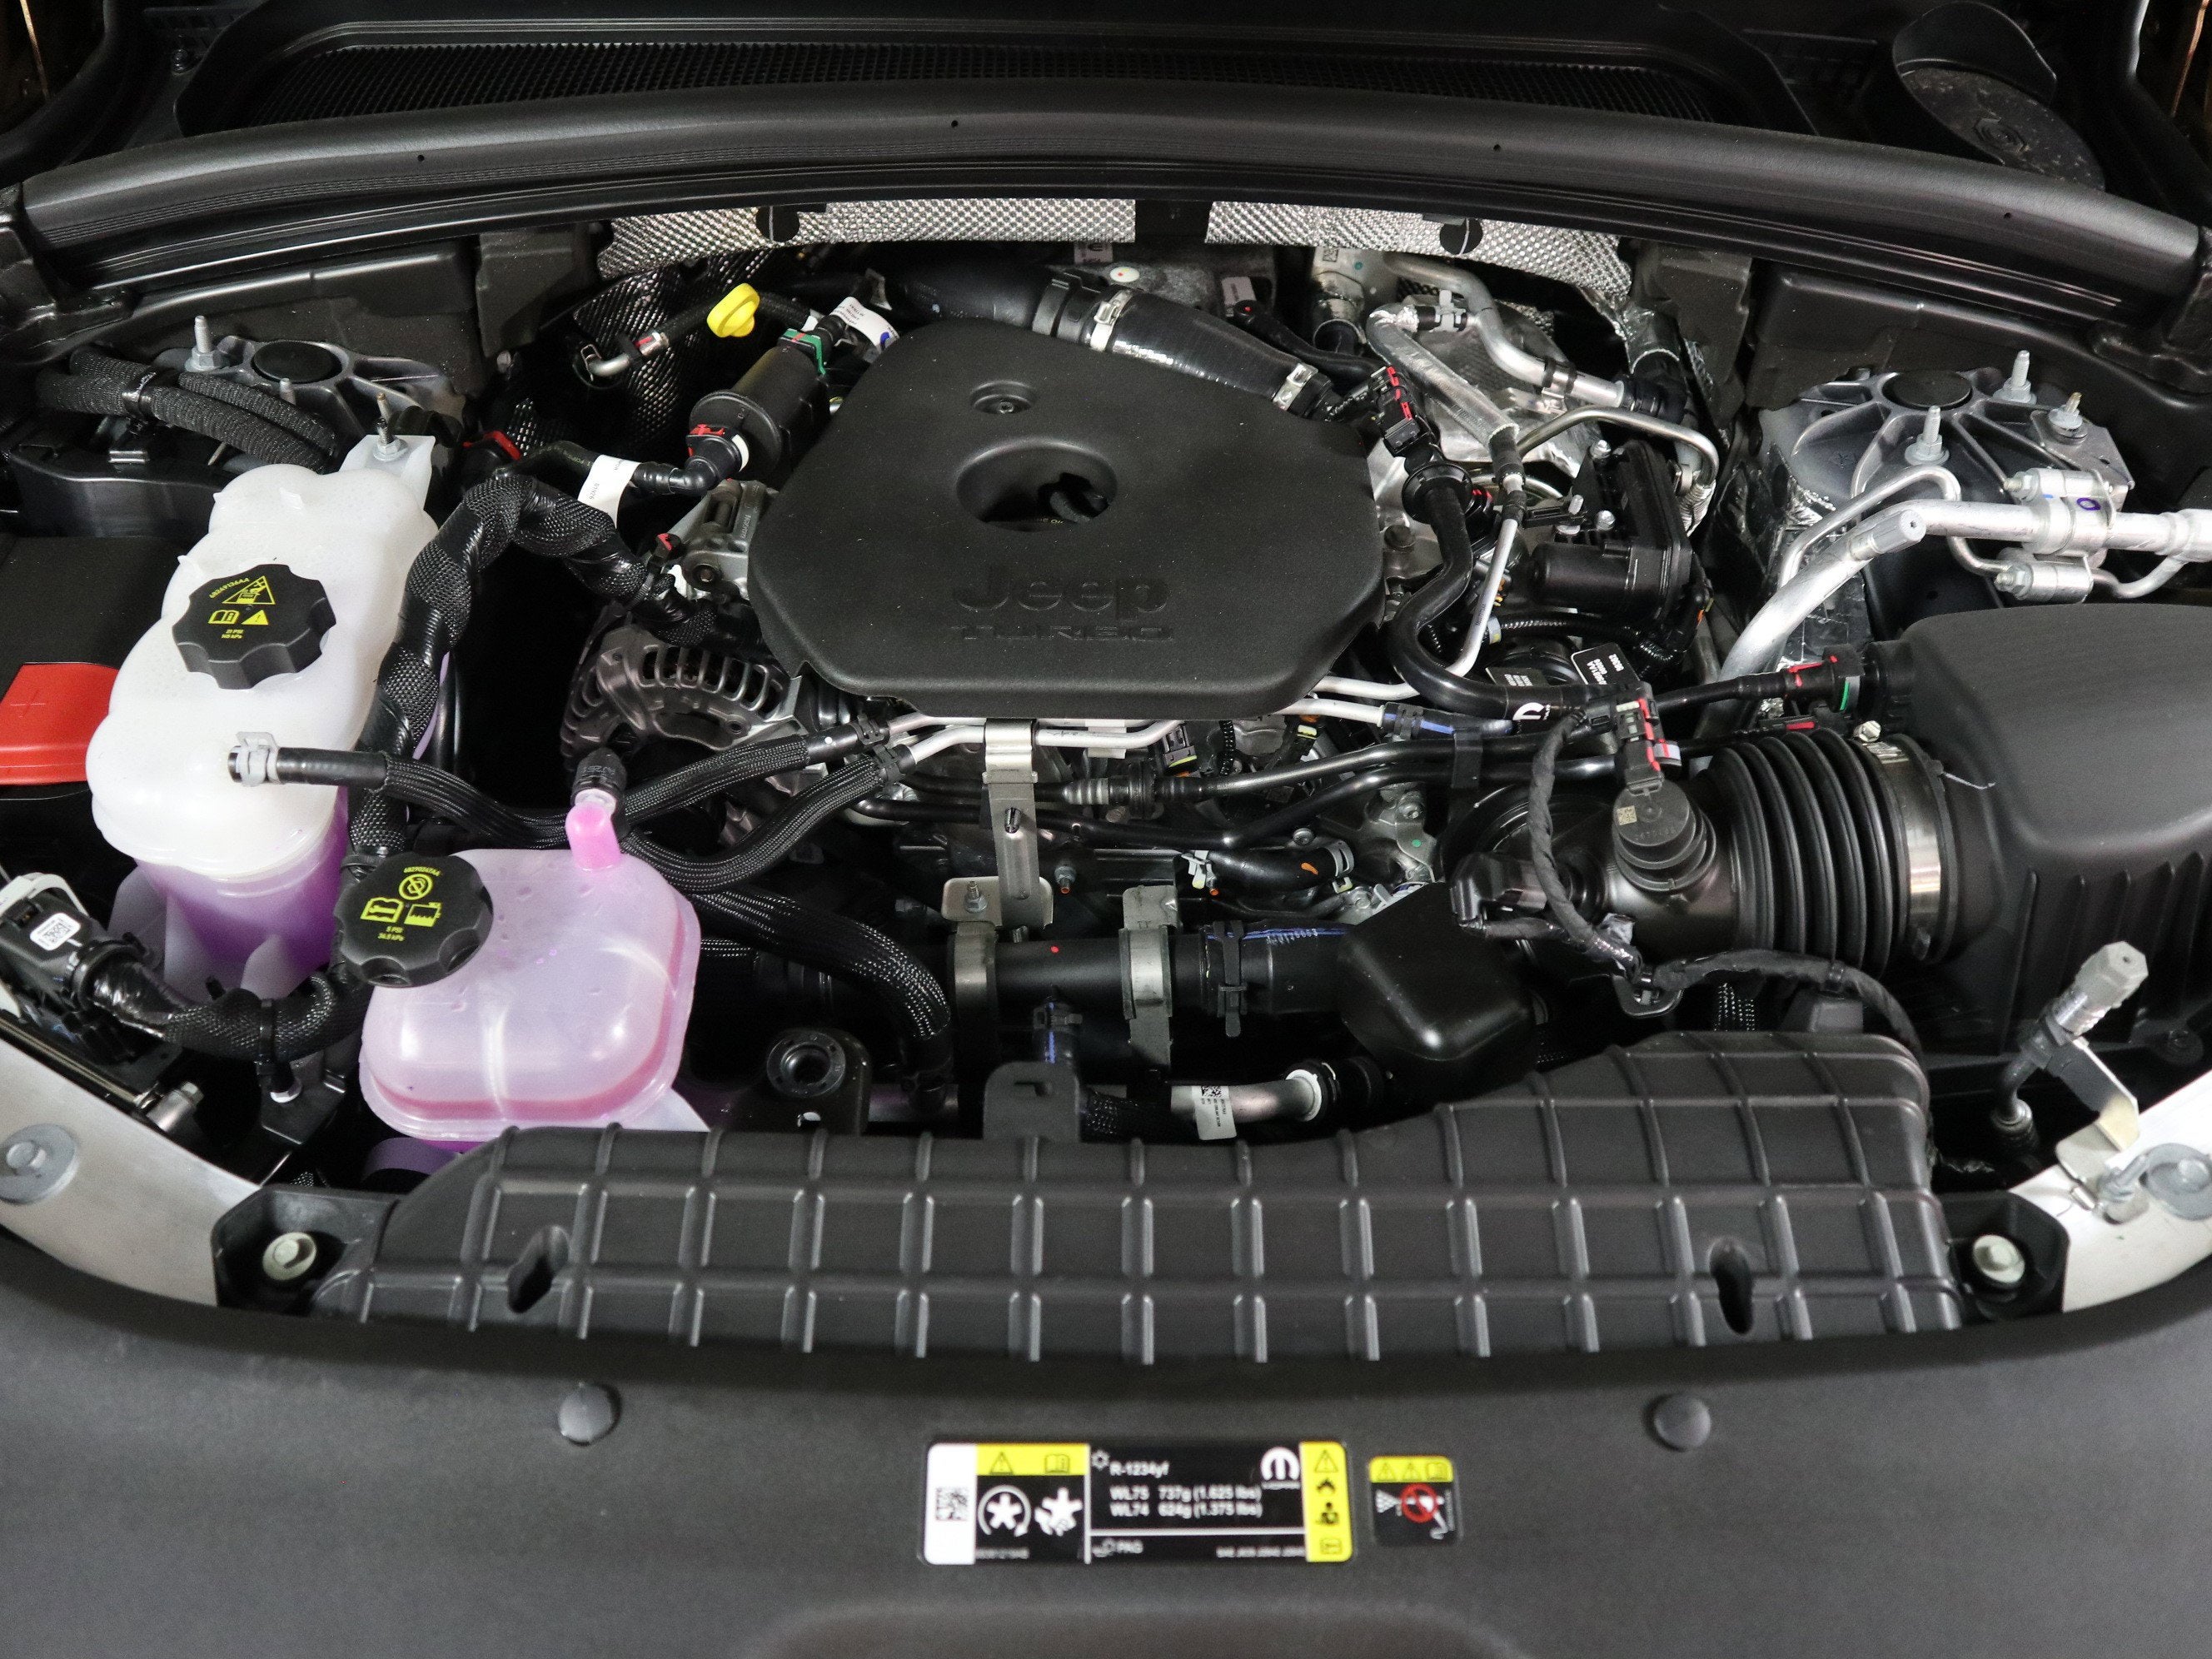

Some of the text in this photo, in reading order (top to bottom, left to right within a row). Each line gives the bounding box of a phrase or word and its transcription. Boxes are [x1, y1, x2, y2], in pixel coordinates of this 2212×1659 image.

[954, 568, 1169, 623] Jeep
[950, 625, 1175, 641] TURBO
[1109, 1461, 1169, 1478] R-1234yf
[1109, 1485, 1149, 1500] WL75
[1158, 1485, 1192, 1502] 737g
[1234, 1485, 1263, 1502] lbs)
[1109, 1501, 1263, 1519] WL74 624g (1.375 lbs)
